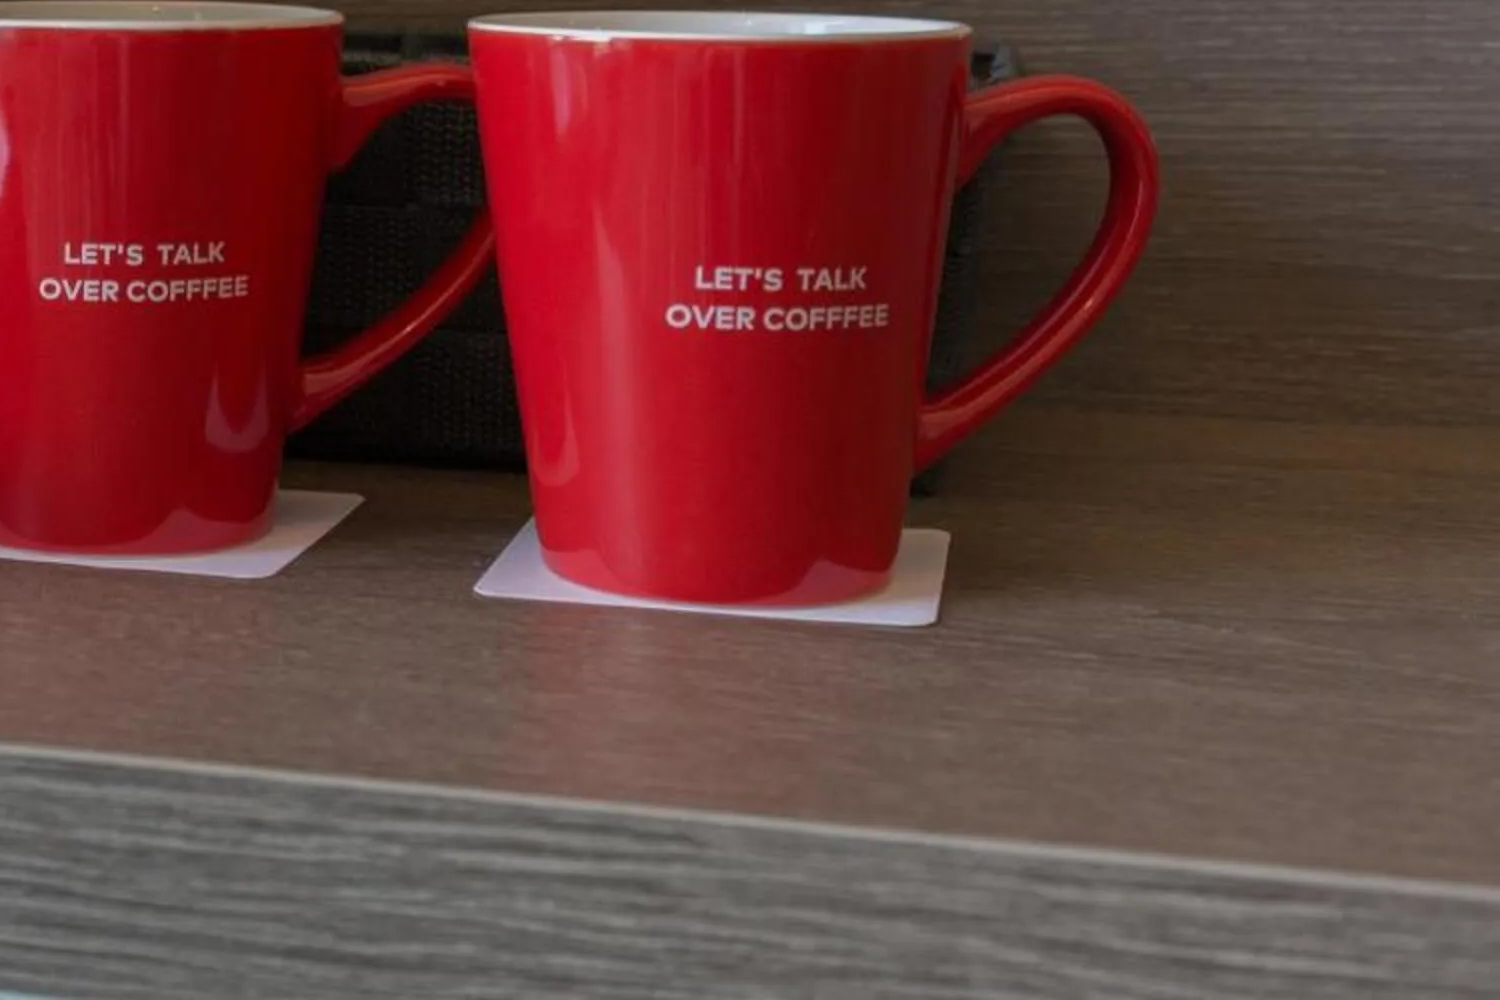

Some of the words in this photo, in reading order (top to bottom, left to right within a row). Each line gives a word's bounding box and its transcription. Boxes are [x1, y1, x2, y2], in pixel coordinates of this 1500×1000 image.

[63, 241, 144, 266] LET'S
[156, 241, 226, 266] TALK
[38, 277, 118, 301] OVER
[126, 275, 249, 302] COFFFEE
[694, 265, 784, 291] LET'S
[796, 265, 868, 291] TALK
[665, 303, 756, 331] OVER
[763, 303, 889, 331] COFFFEE
